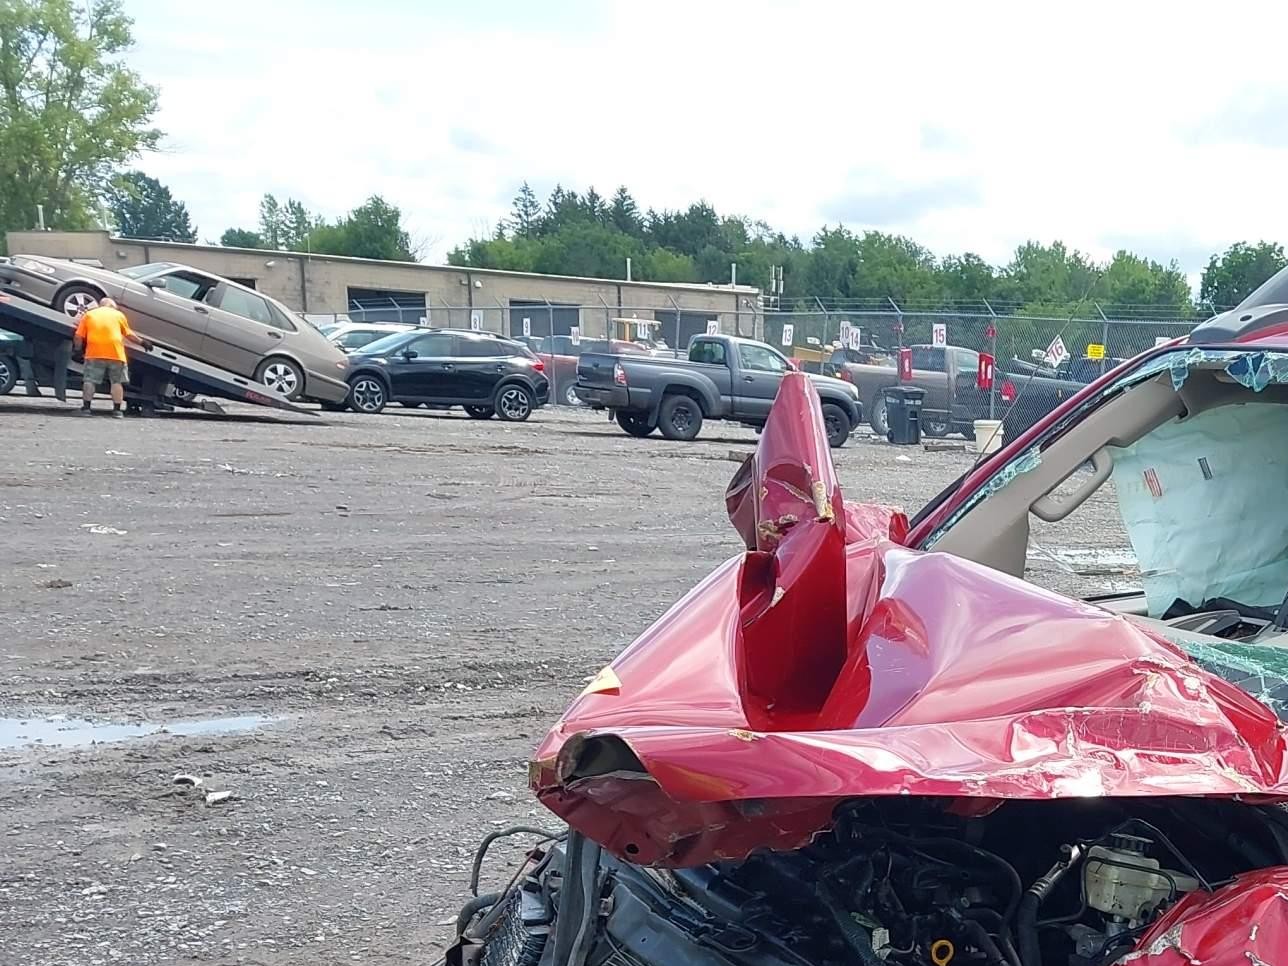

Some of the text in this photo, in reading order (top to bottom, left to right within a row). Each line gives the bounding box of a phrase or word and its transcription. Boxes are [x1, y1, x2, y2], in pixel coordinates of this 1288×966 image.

[784, 328, 792, 343] 13
[850, 331, 859, 346] 14
[934, 328, 945, 343] 15
[1049, 341, 1064, 361] 16
